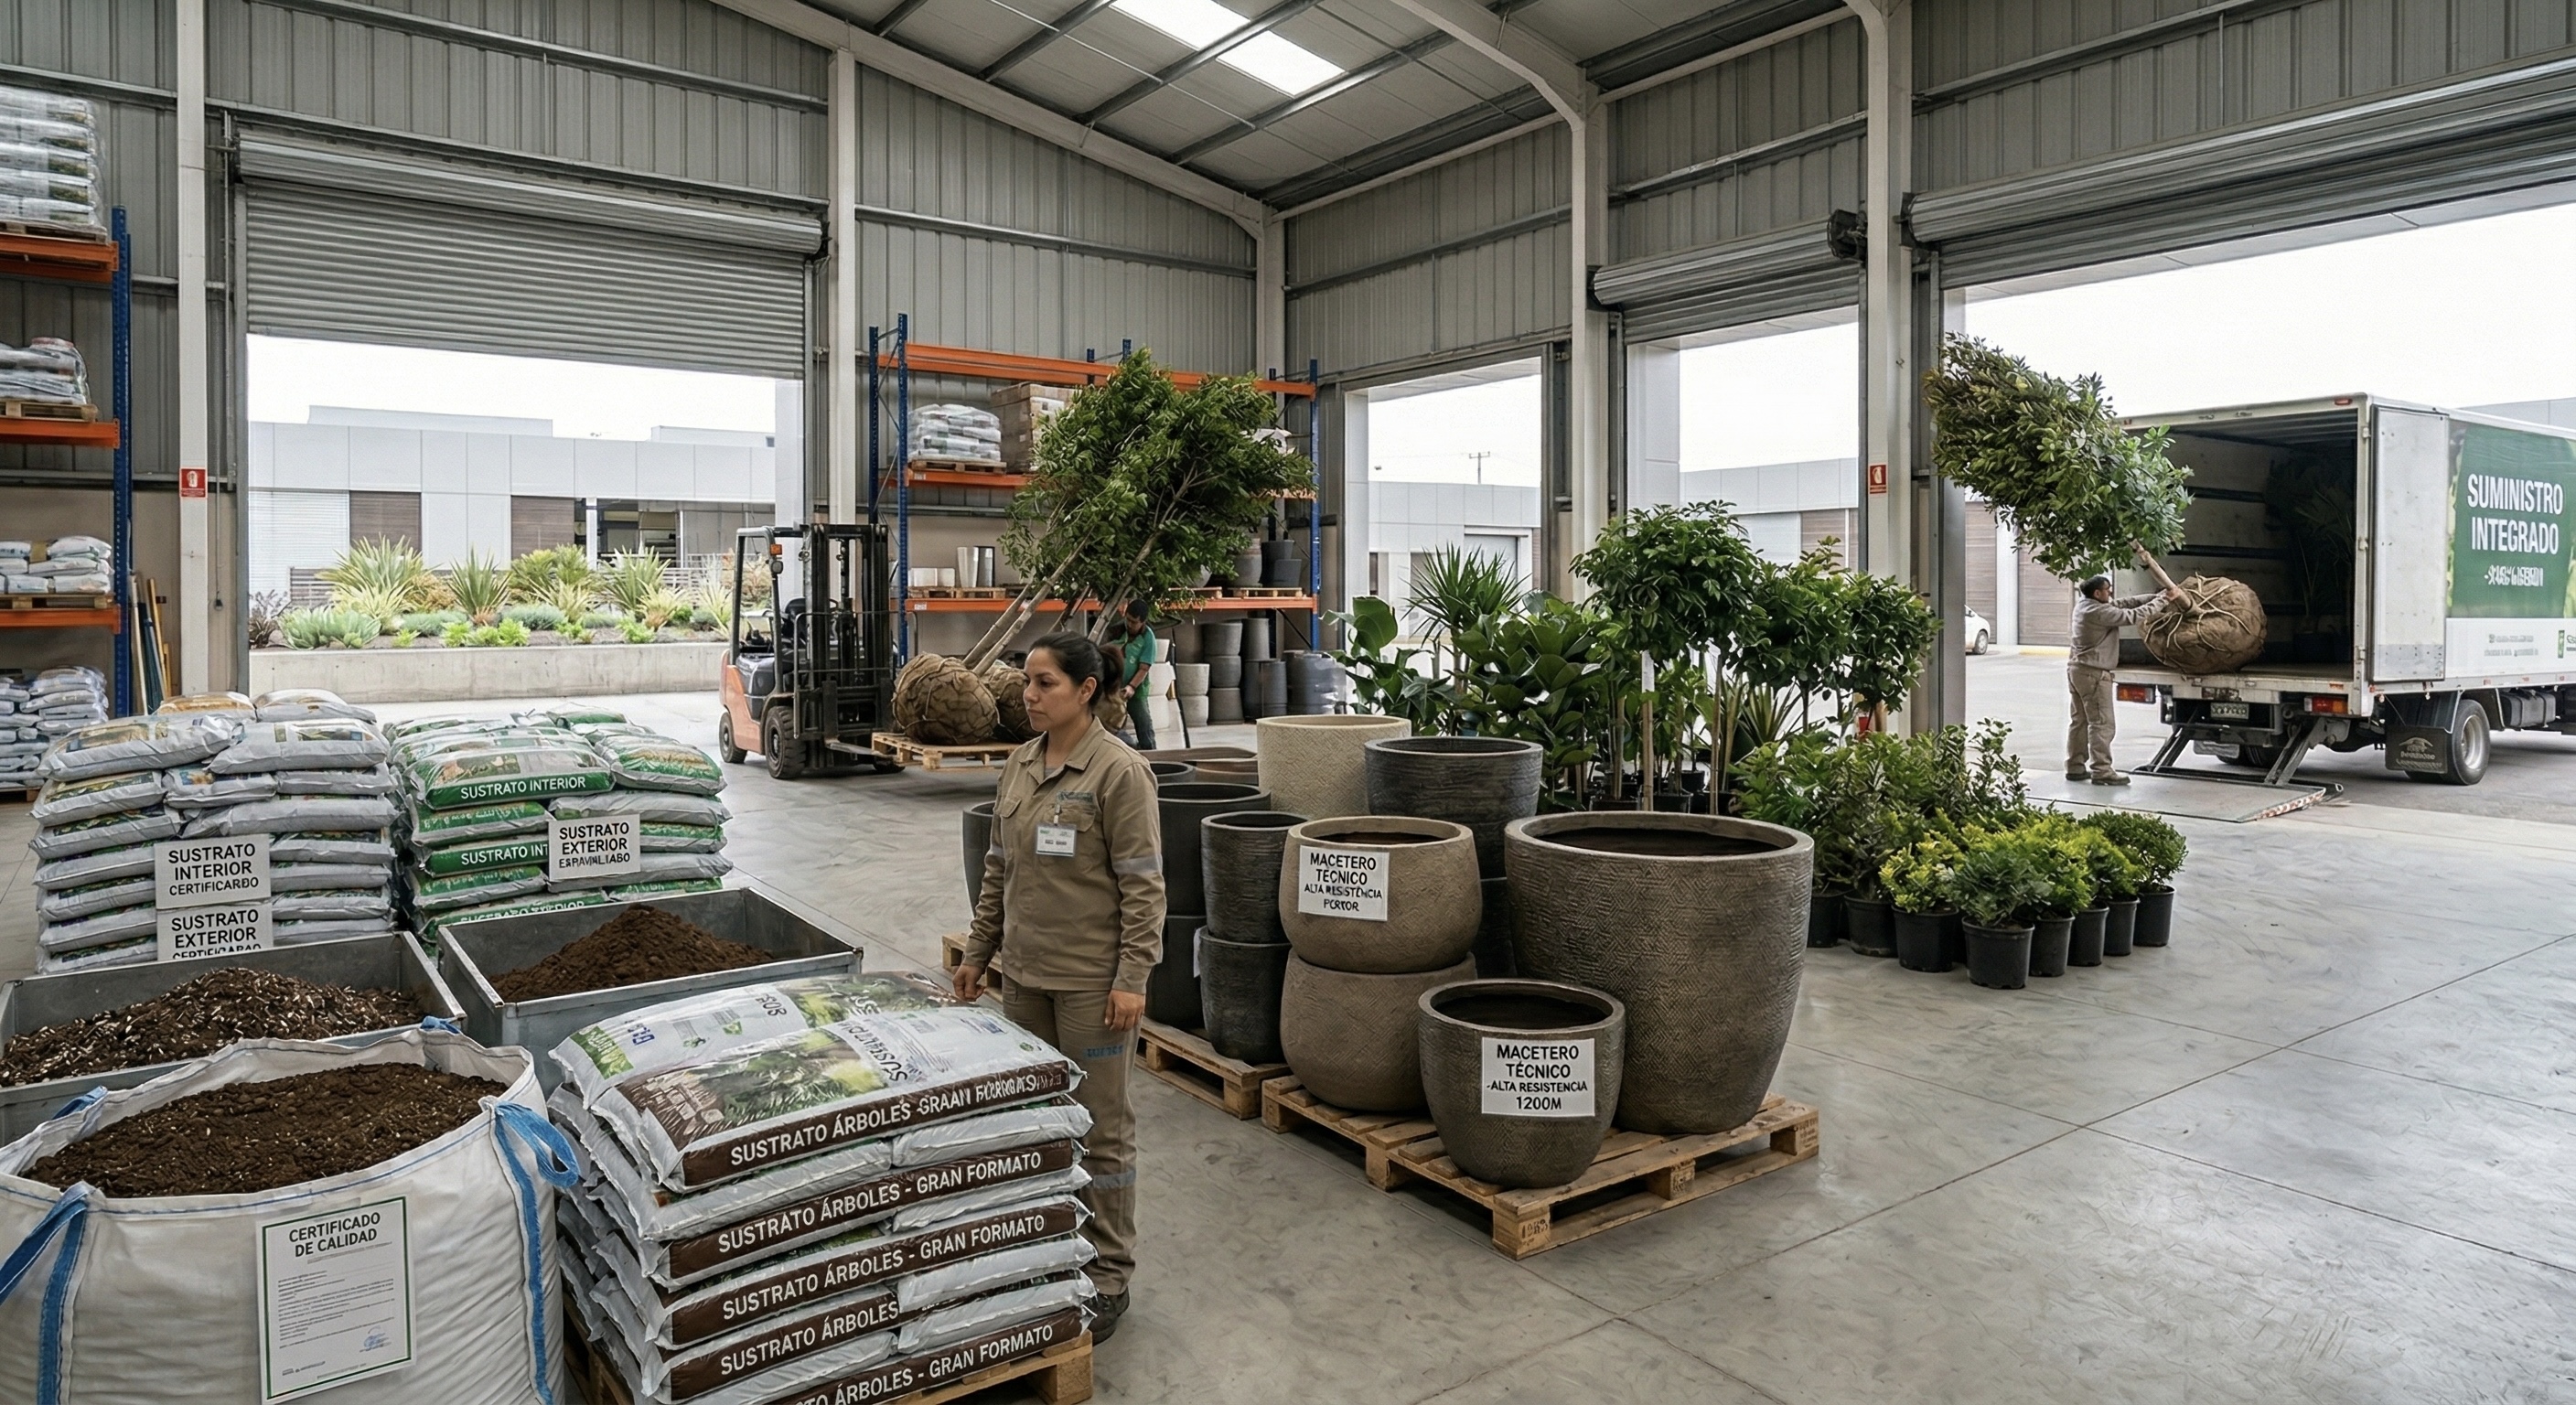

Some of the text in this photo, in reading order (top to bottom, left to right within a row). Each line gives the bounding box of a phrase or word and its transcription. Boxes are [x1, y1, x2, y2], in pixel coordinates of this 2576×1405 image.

[2467, 473, 2563, 515] SUMINISTRO
[2472, 517, 2559, 555] INTEGRADO
[460, 777, 586, 799] SUSTRATO INTERIOR
[559, 822, 629, 840] SUSTRATO
[168, 843, 255, 863] SUSTRATO
[461, 846, 528, 865] SUSTRATO
[562, 838, 628, 855] EXTERIOR
[175, 861, 252, 880] INTERIOR
[1310, 853, 1376, 870] MACETERO
[171, 909, 259, 931] SUSTRATO
[175, 927, 256, 949] EXTERIOR
[1497, 1045, 1579, 1060] MACETERO
[1506, 1061, 1571, 1078] TÉCNICO
[1519, 1081, 1587, 1093] RESISTENCIA
[1517, 1096, 1562, 1110] 1200M
[731, 1124, 827, 1166] SUSTRATO
[832, 1101, 911, 1138] ÁRBOLES
[718, 1207, 814, 1252] SUSTRATO
[821, 1184, 900, 1221] ÁRBOLES
[917, 1166, 962, 1194] GRAN
[967, 1152, 1041, 1183] FORMATO
[289, 1212, 381, 1242] CERTIFICADO
[295, 1242, 313, 1257] DE
[317, 1228, 377, 1251] CALIDAD
[723, 1274, 818, 1320] SUSTRATO
[824, 1249, 903, 1288] ÁRBOLES
[920, 1234, 965, 1260] GRAN
[971, 1215, 1045, 1247] FORMATO
[721, 1301, 898, 1375] SUSTRATO ÁRBOLES
[835, 1368, 913, 1405] ÁRBOLES
[929, 1354, 974, 1378] GRAN
[980, 1325, 1052, 1363] FORMATO
